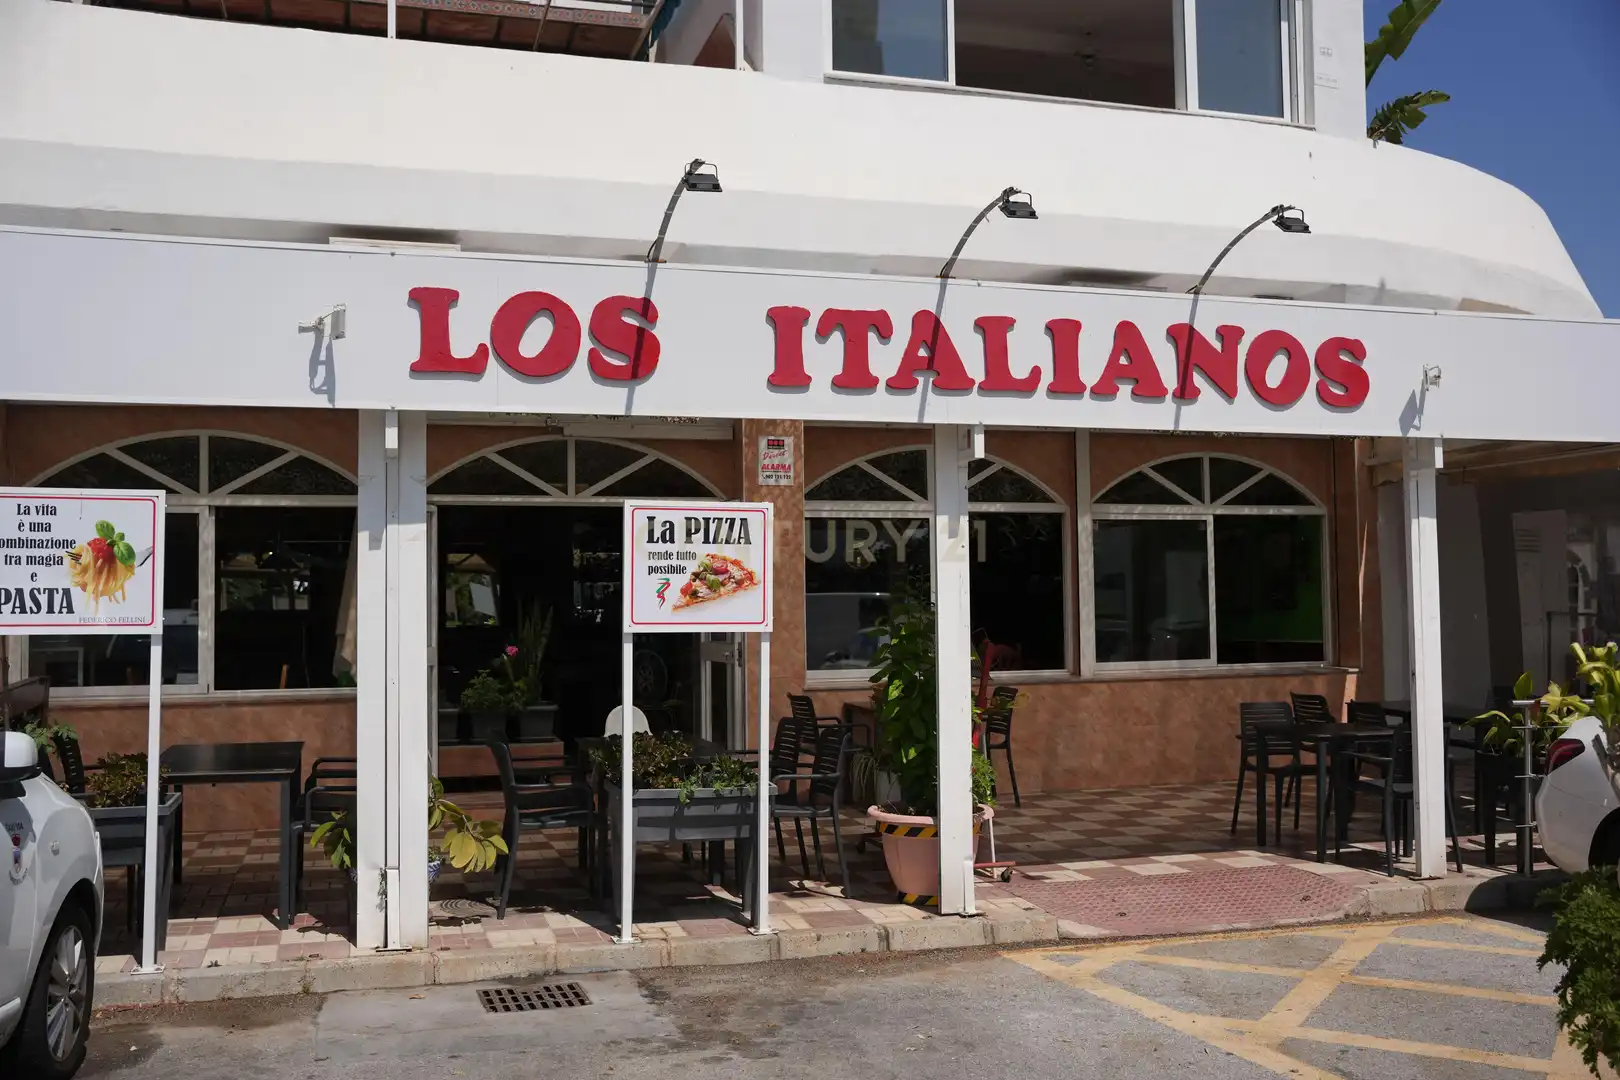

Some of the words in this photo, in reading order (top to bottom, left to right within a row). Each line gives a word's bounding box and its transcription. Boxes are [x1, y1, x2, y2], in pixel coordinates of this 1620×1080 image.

[409, 288, 660, 381] LOS
[767, 306, 1370, 408] ITALIANOS
[16, 503, 31, 516] La
[35, 503, 57, 516] vita
[18, 519, 25, 532] è
[29, 522, 51, 532] una
[646, 516, 675, 544] La
[684, 516, 752, 545] PIZZA
[0, 536, 76, 549] ombinazione
[4, 553, 22, 566] tra
[26, 553, 64, 567] magia
[648, 550, 674, 561] rende
[676, 550, 697, 561] tutto
[647, 563, 687, 576] possibile
[30, 571, 38, 582] e
[0, 587, 75, 614] PASTA
[79, 616, 117, 624] FEDERICO
[118, 616, 146, 624] FELLINI
